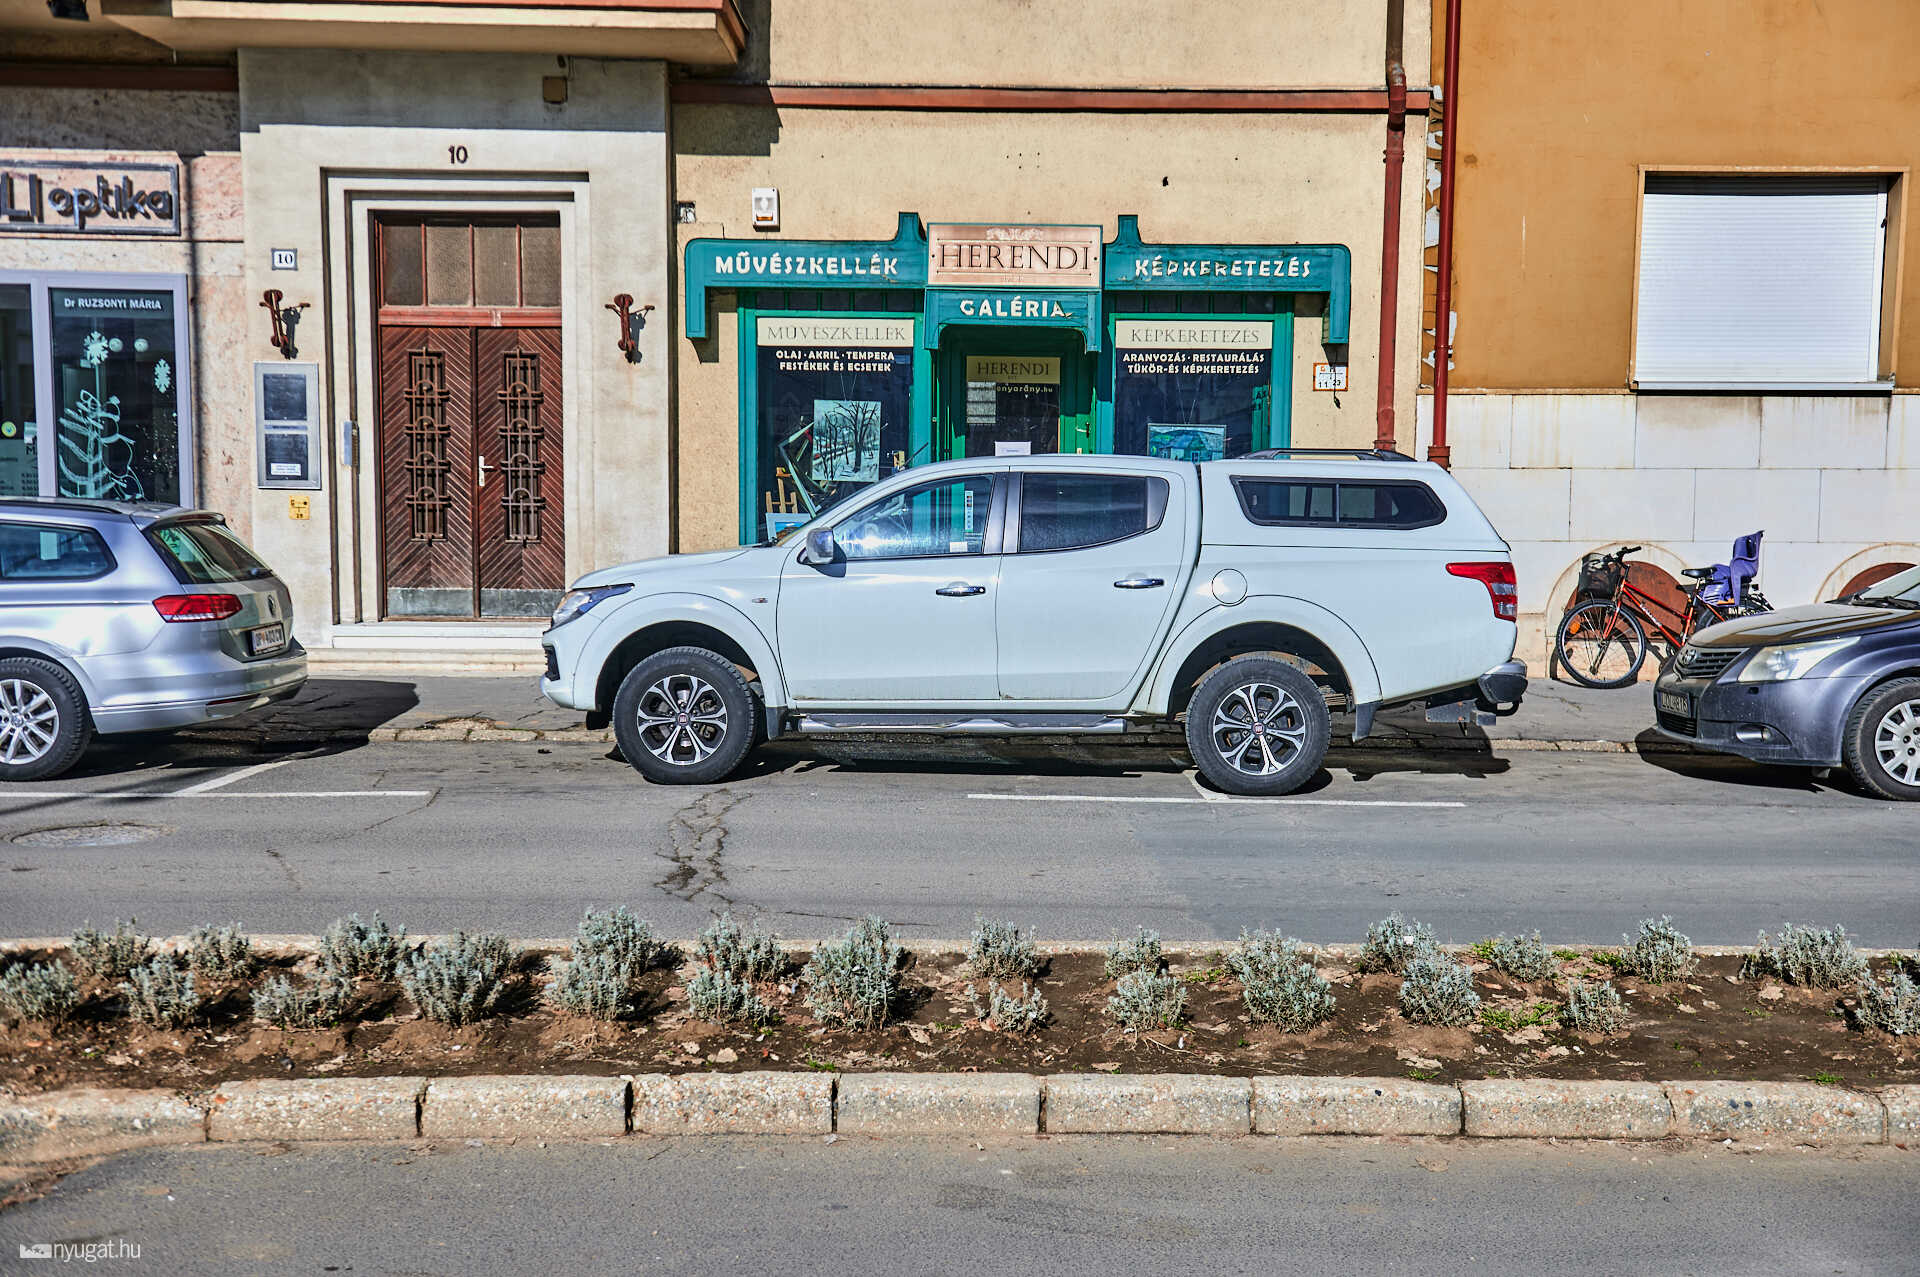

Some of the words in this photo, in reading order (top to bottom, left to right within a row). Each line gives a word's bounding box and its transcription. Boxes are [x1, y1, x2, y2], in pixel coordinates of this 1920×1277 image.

[448, 145, 468, 164] 10
[48, 175, 171, 227] optika
[279, 253, 293, 264] 10
[715, 251, 898, 275] MŰVÉSZKELLÉK
[939, 244, 1089, 270] HERENDI
[1135, 255, 1311, 278] KÉPKERETEZÉS
[64, 298, 75, 307] Dr
[78, 298, 127, 309] RUZSONYI
[129, 298, 161, 310] MÁRIA
[959, 296, 1067, 318] GALÉRIA
[776, 351, 801, 359] OLAJ
[808, 351, 840, 360] AKRIL
[846, 352, 895, 361] TEMPERA
[1122, 352, 1186, 362] ARANYOZÁS
[1192, 352, 1265, 363] RESTAURÁLÁS
[780, 361, 830, 371] FESTÉKEK
[833, 361, 844, 371] ÉS
[847, 363, 891, 372] ECSETEK
[977, 361, 1049, 376] HERENDI
[1182, 364, 1259, 374] KÉPKERETEZÉS
